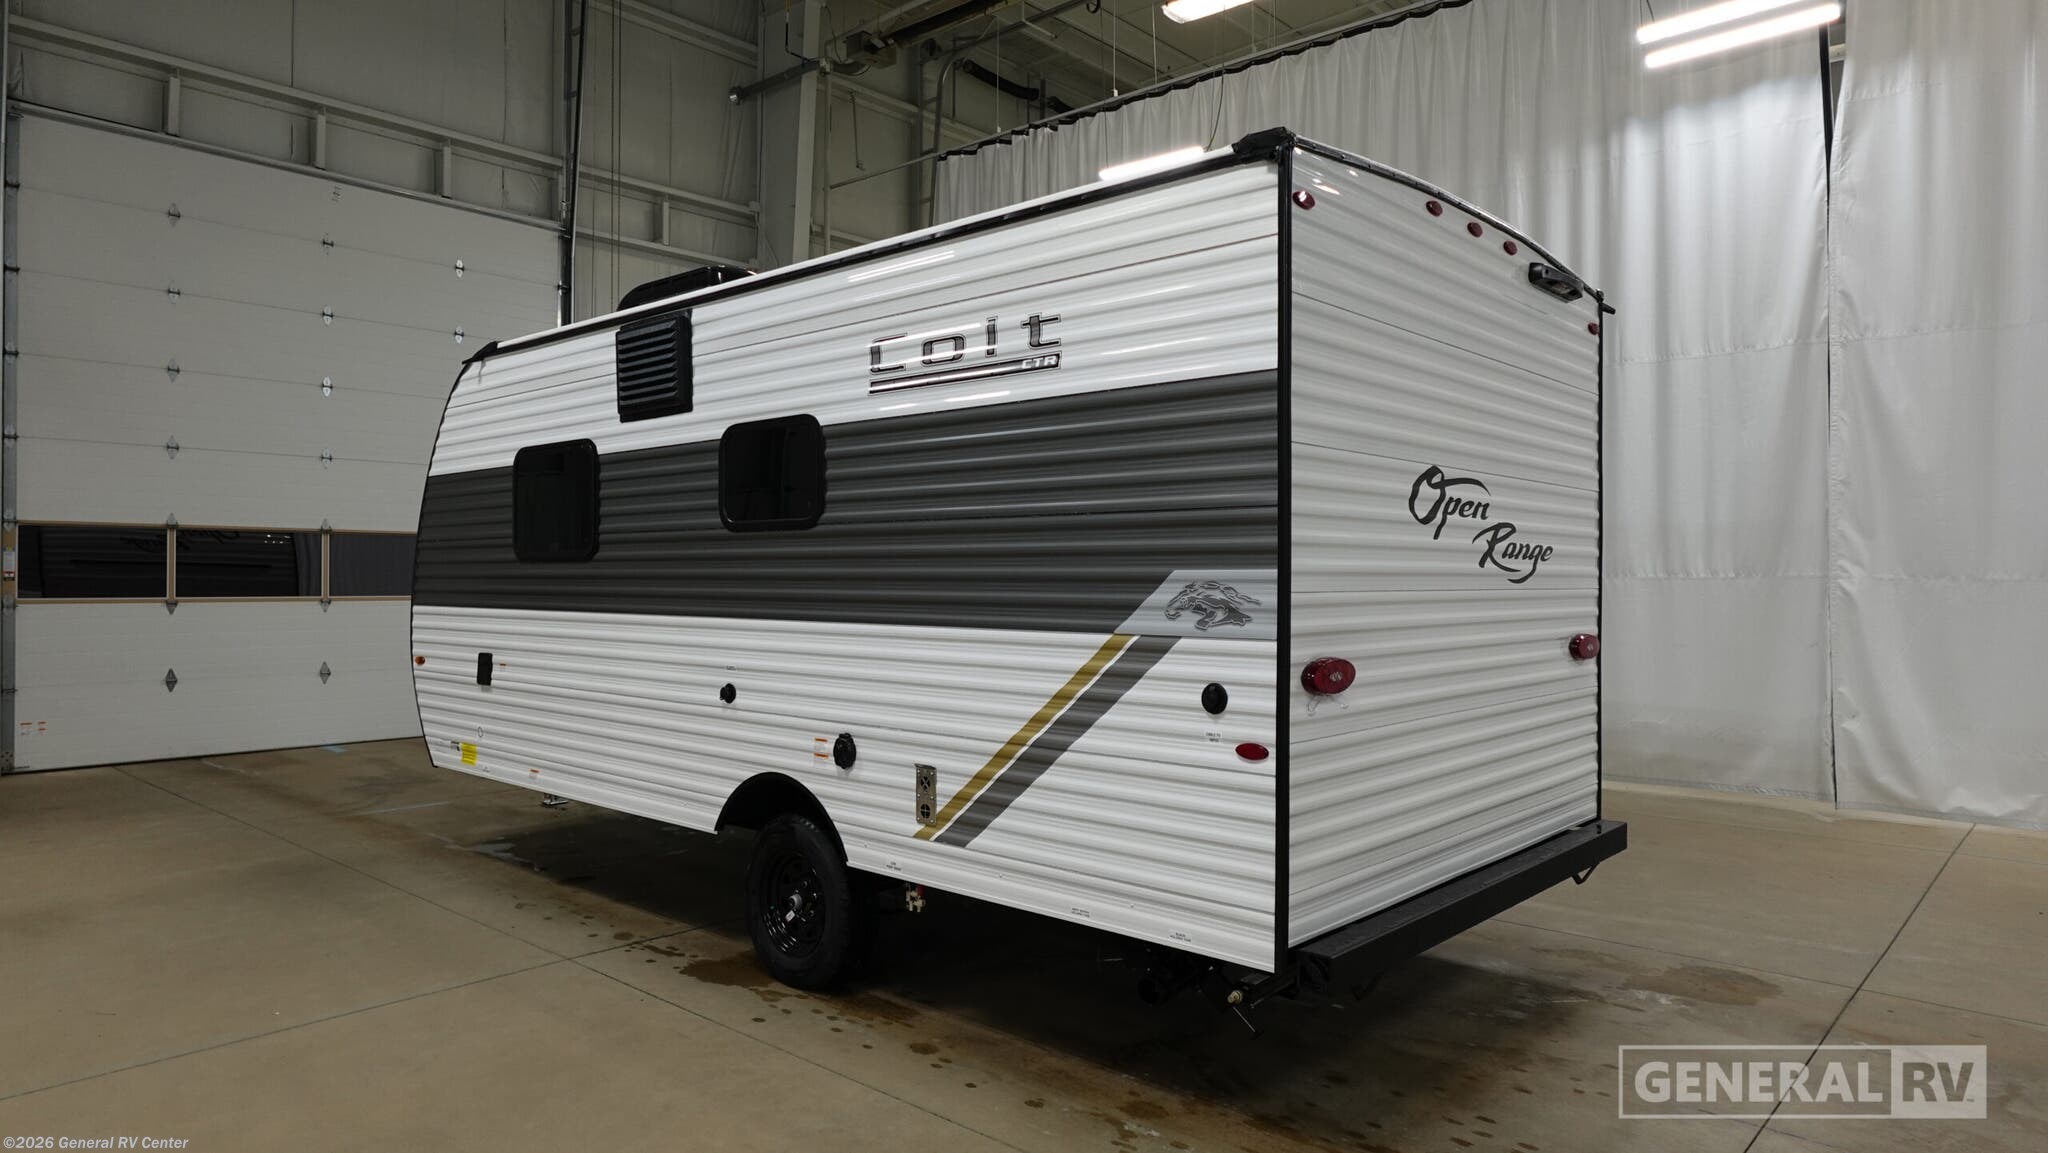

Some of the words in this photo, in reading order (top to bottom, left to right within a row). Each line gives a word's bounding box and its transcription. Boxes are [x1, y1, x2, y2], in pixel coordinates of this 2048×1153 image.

[869, 312, 1062, 374] Colt
[1021, 353, 1058, 370] CTR
[1408, 465, 1491, 540] Open
[1472, 522, 1554, 584] Range
